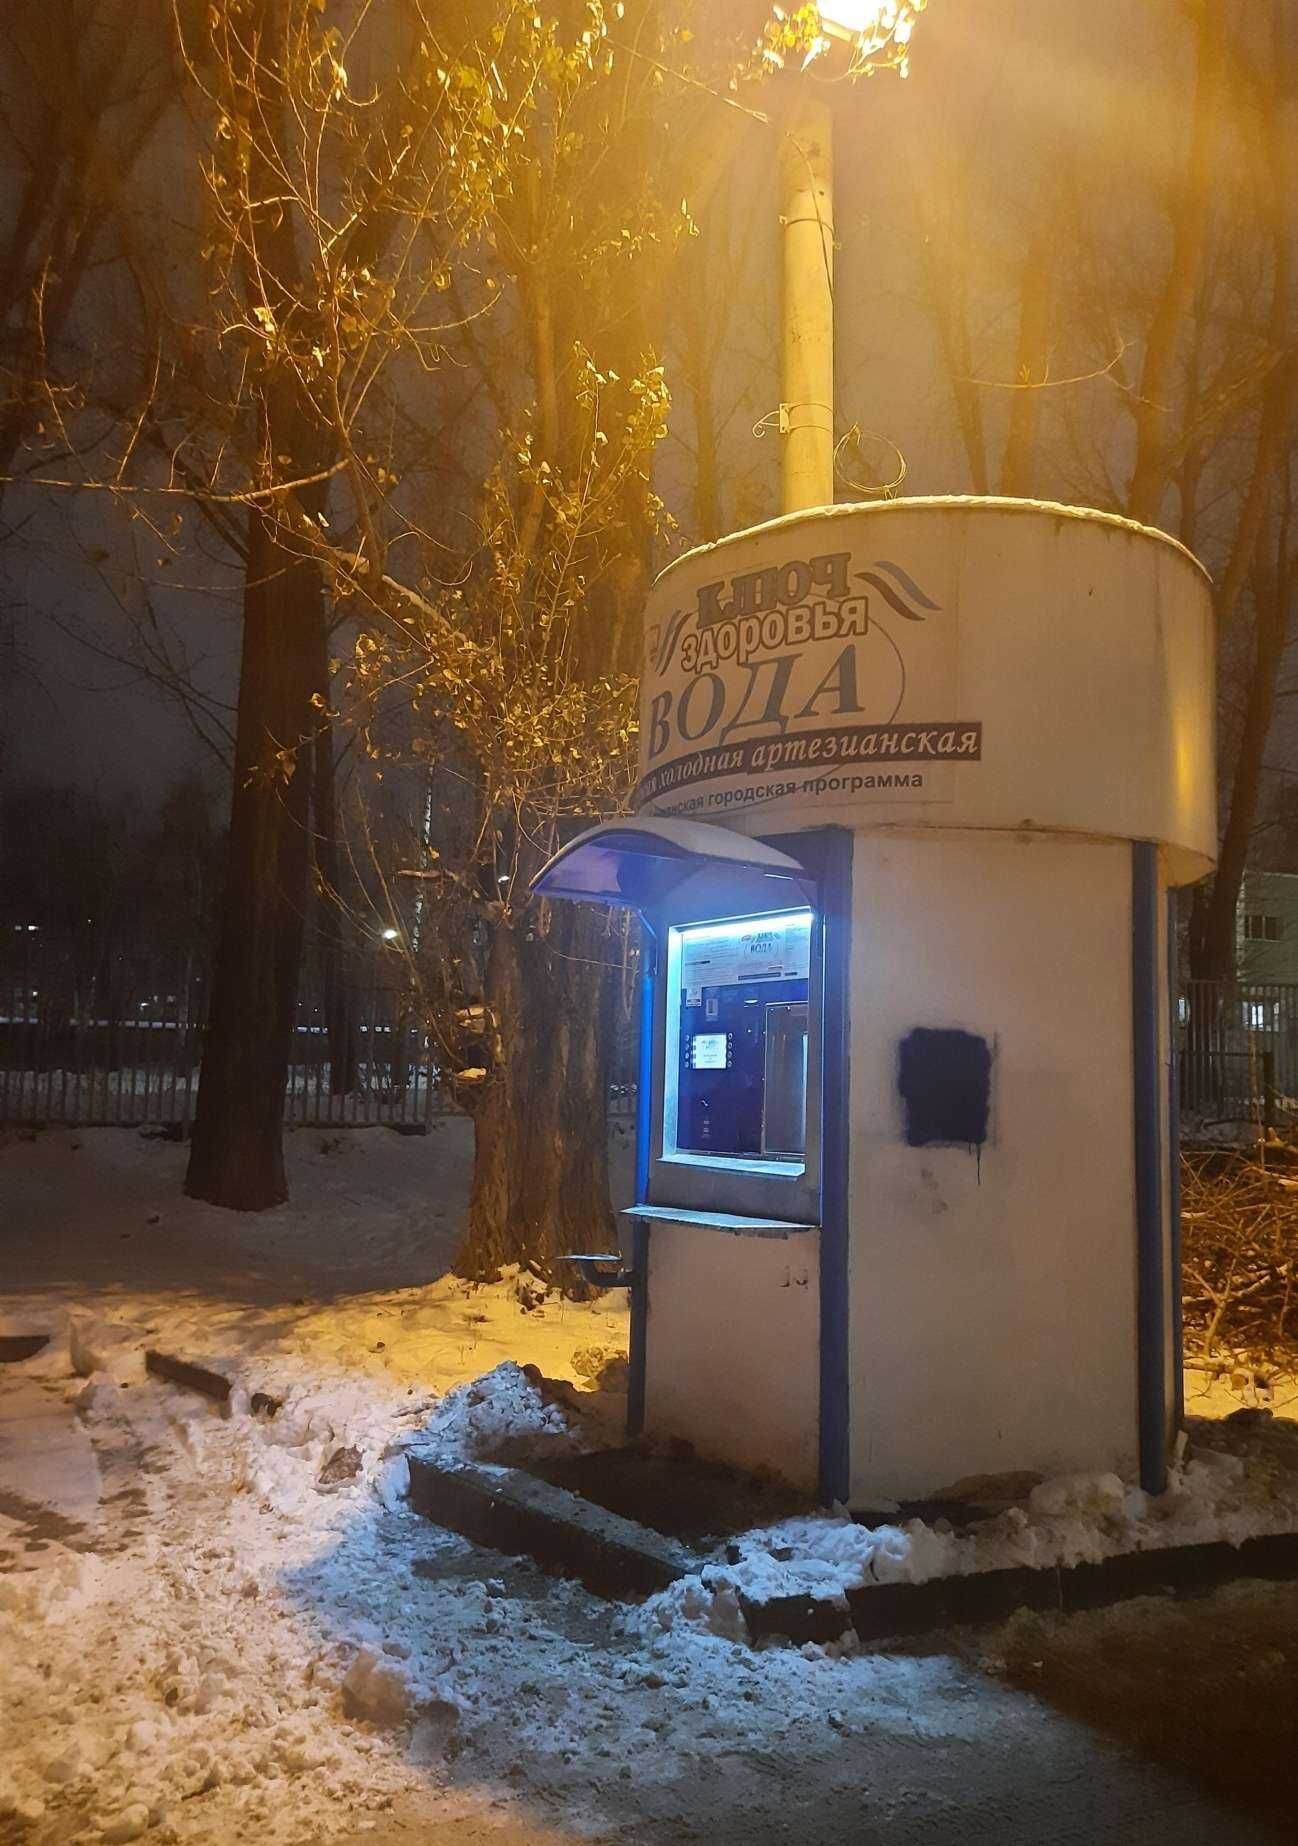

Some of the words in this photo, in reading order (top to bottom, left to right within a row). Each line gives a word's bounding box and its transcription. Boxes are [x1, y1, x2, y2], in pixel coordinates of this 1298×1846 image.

[649, 643, 866, 760] ВОДА
[659, 747, 744, 790] холодная
[750, 728, 979, 772] артезианская
[708, 780, 796, 807] городская
[802, 771, 924, 796] программа
